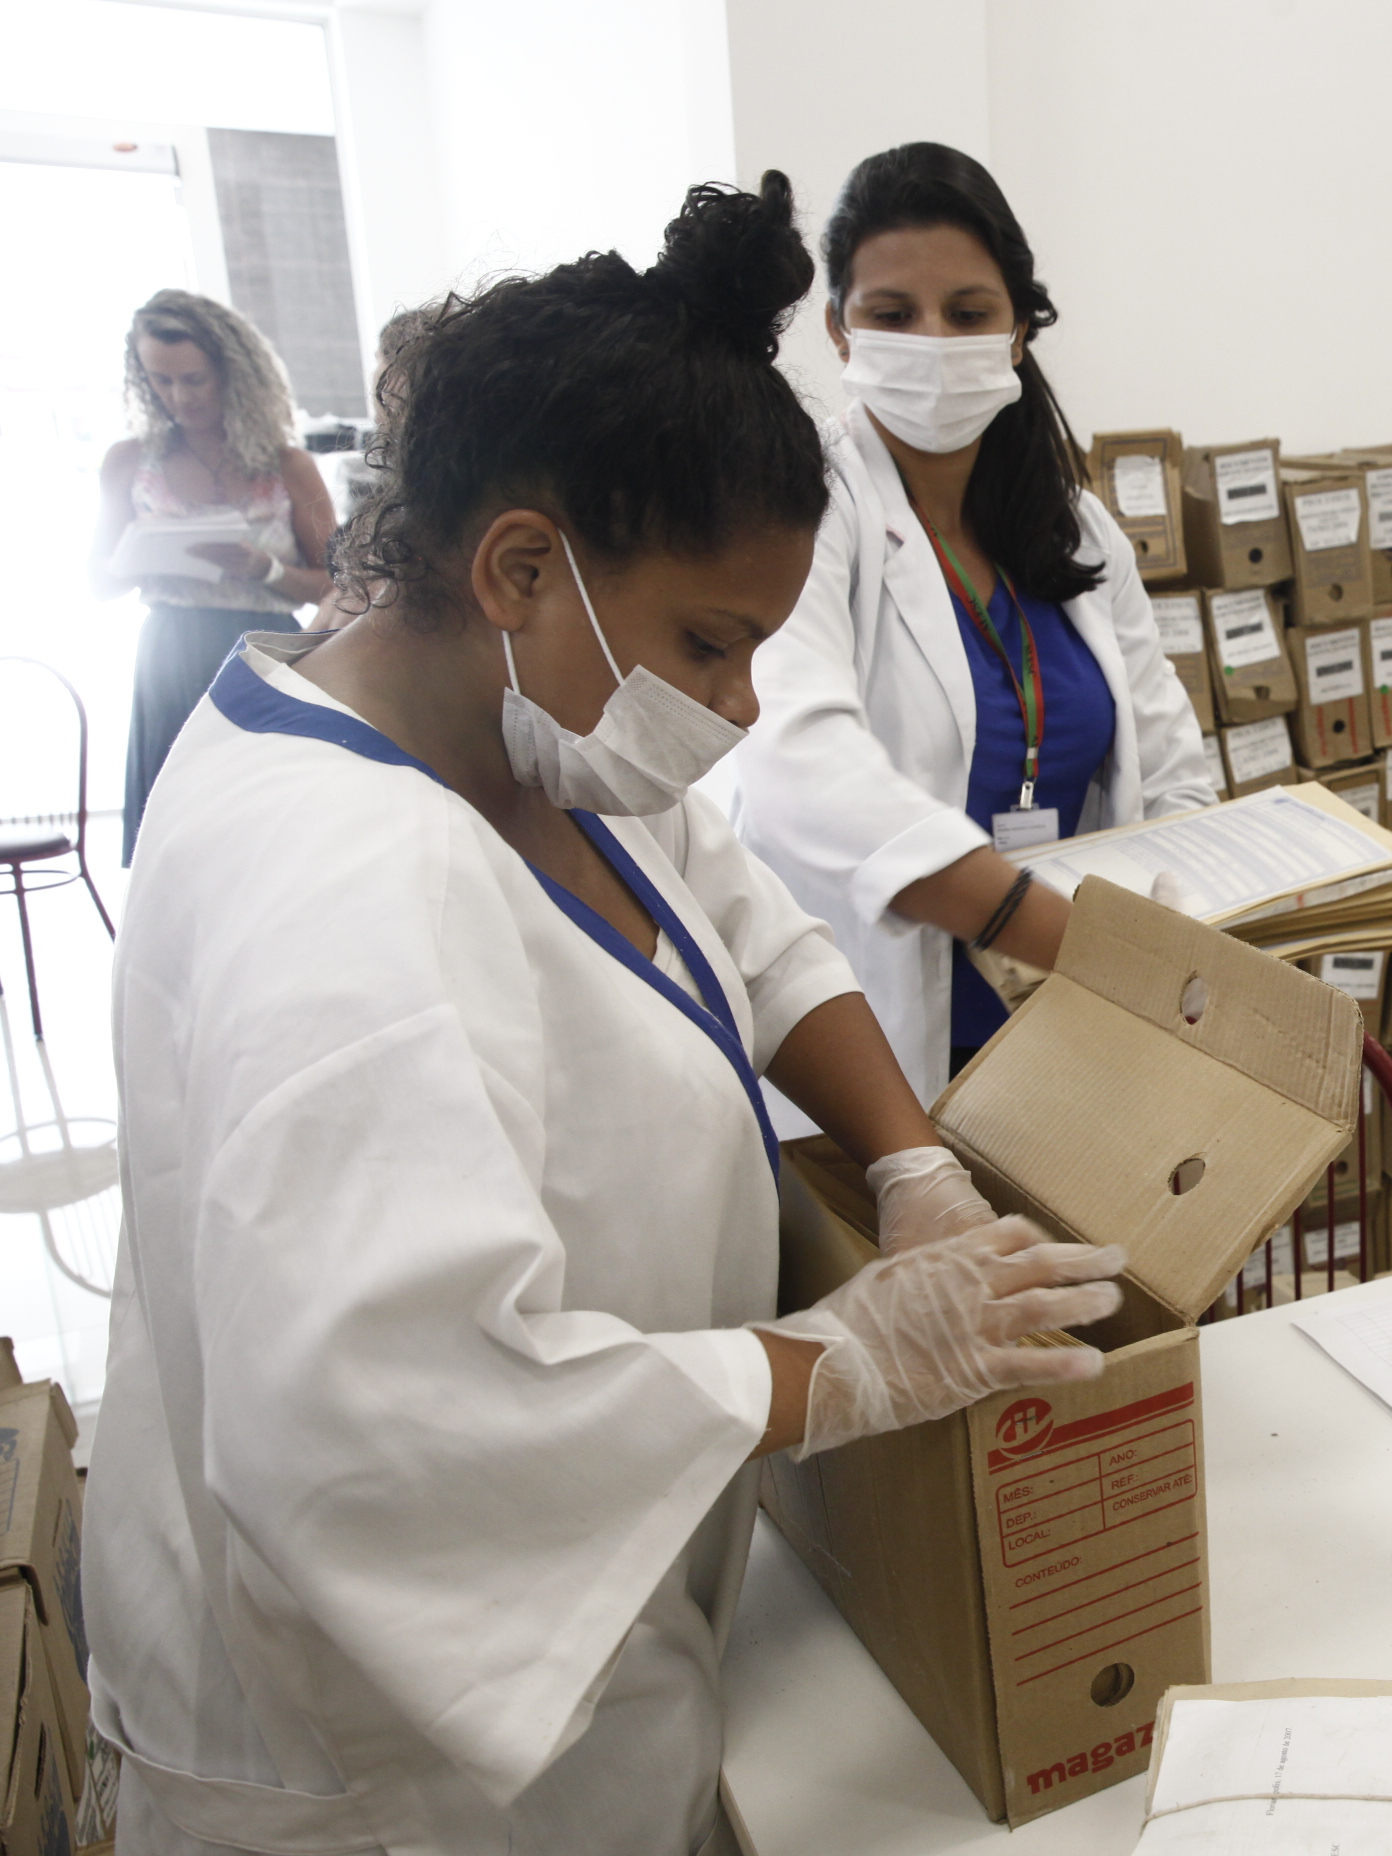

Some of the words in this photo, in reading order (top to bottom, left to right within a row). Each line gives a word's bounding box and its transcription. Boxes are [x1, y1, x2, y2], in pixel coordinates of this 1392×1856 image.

[1109, 1449, 1137, 1466] ANO:
[1111, 1474, 1138, 1490] REF.:
[1003, 1485, 1034, 1504] MÊS:
[1112, 1482, 1171, 1511] CONSERVAR
[1172, 1473, 1192, 1491] ATÉ:
[1006, 1512, 1037, 1529] DEP.:
[1008, 1530, 1051, 1550] LOCAL:
[1015, 1556, 1083, 1588] CONTEÚDO:
[1280, 1747, 1289, 1764] agosto
